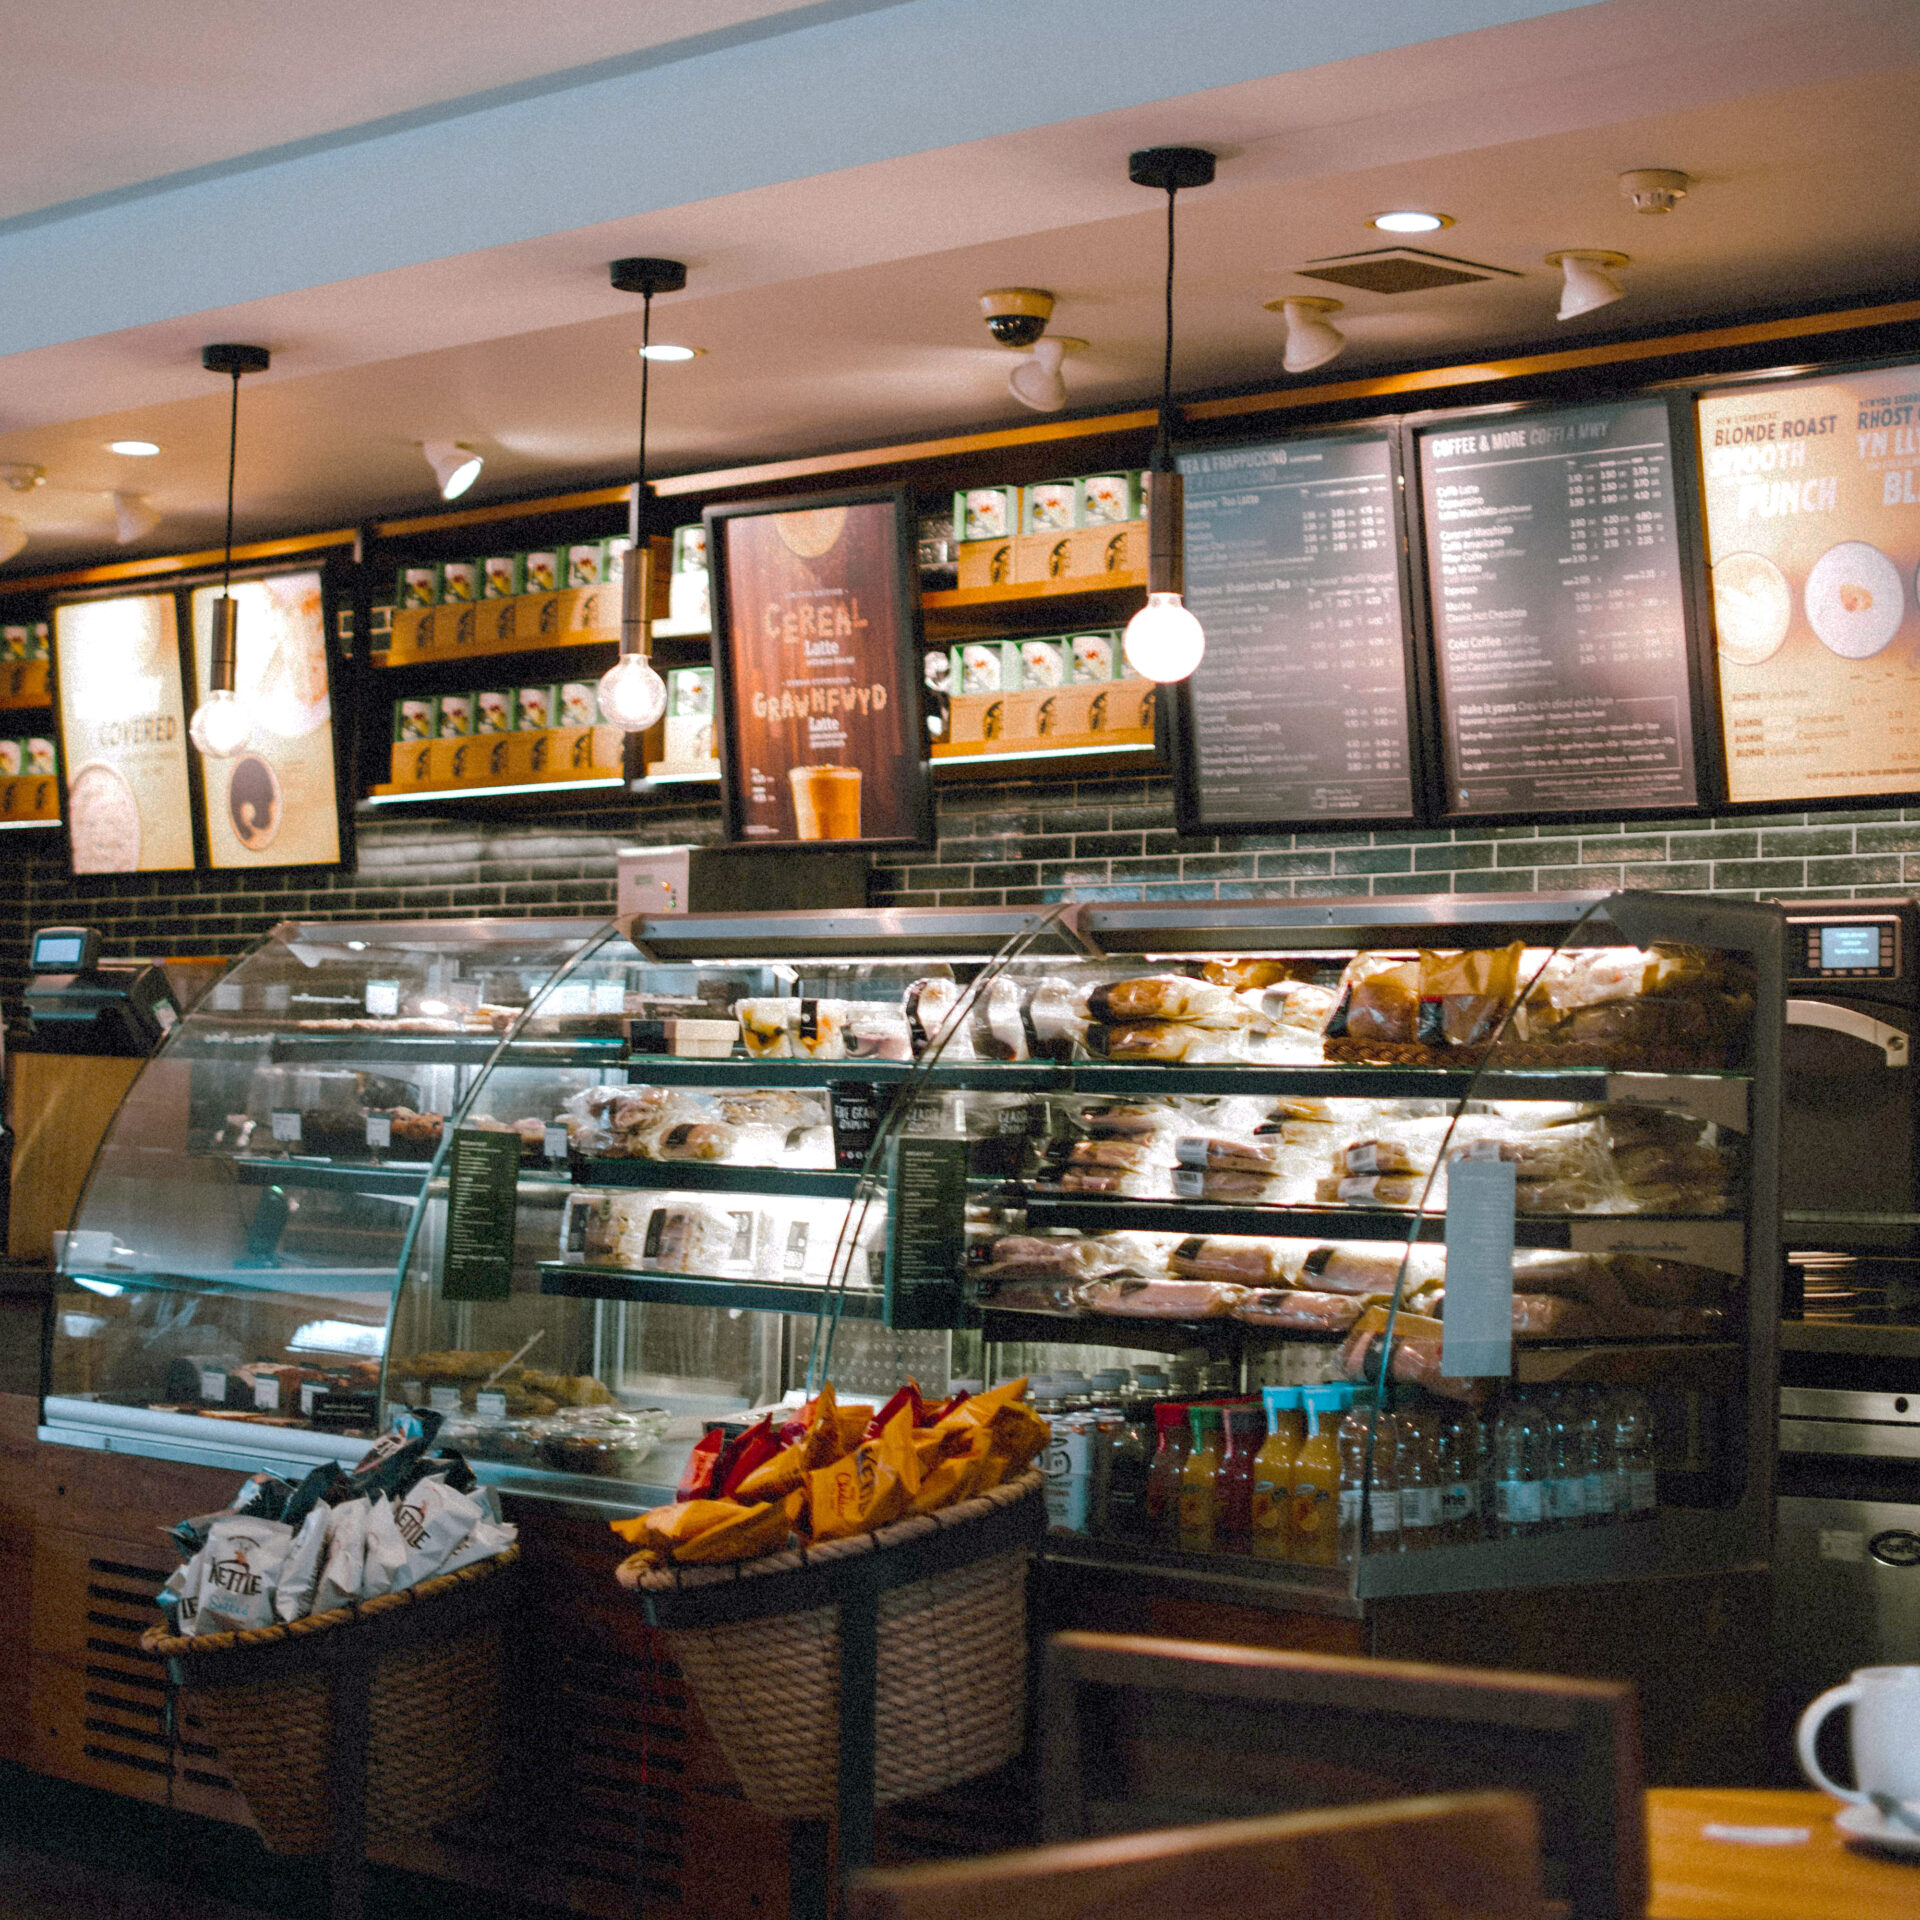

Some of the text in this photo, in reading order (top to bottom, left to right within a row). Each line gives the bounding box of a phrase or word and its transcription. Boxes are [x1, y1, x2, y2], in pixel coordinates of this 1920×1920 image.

[1714, 415, 1837, 447] BLONDE ROAST
[1857, 406, 1913, 430] RHOST
[1432, 436, 1477, 458] COFFEE
[1479, 433, 1490, 452] &
[1491, 431, 1527, 449] MORE
[1737, 476, 1837, 519] PUNCH
[764, 597, 869, 644] CEREAL
[803, 639, 840, 657] Latte
[752, 683, 888, 723] GRAWNFWYD
[808, 716, 841, 732] Latte
[208, 1556, 262, 1597] KETTLE
